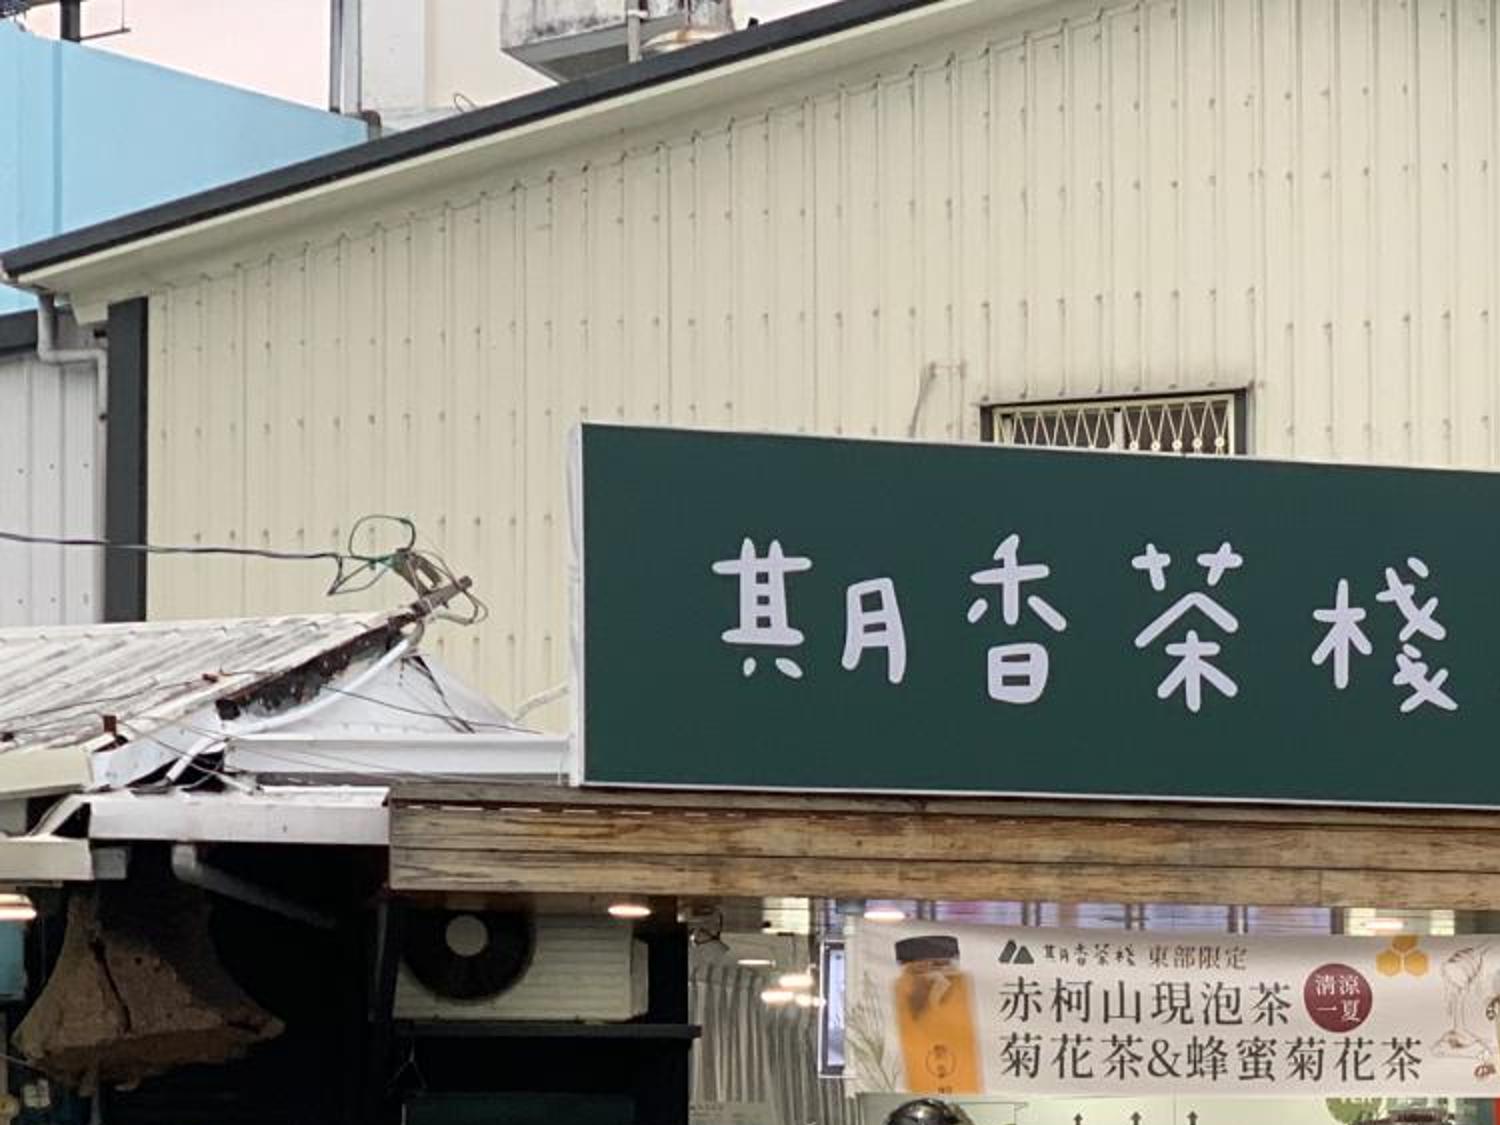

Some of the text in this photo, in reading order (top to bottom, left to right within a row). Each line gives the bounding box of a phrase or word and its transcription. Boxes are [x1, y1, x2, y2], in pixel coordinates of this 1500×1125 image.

[711, 534, 1460, 713] 期香茶棧
[1149, 945, 1248, 970] 東部限定
[1000, 975, 1292, 1027] 赤柯山現泡茶
[1316, 1000, 1361, 1023] 一夏
[1000, 1032, 1423, 1084] 菊花茶&蜂蜜菊花茶
